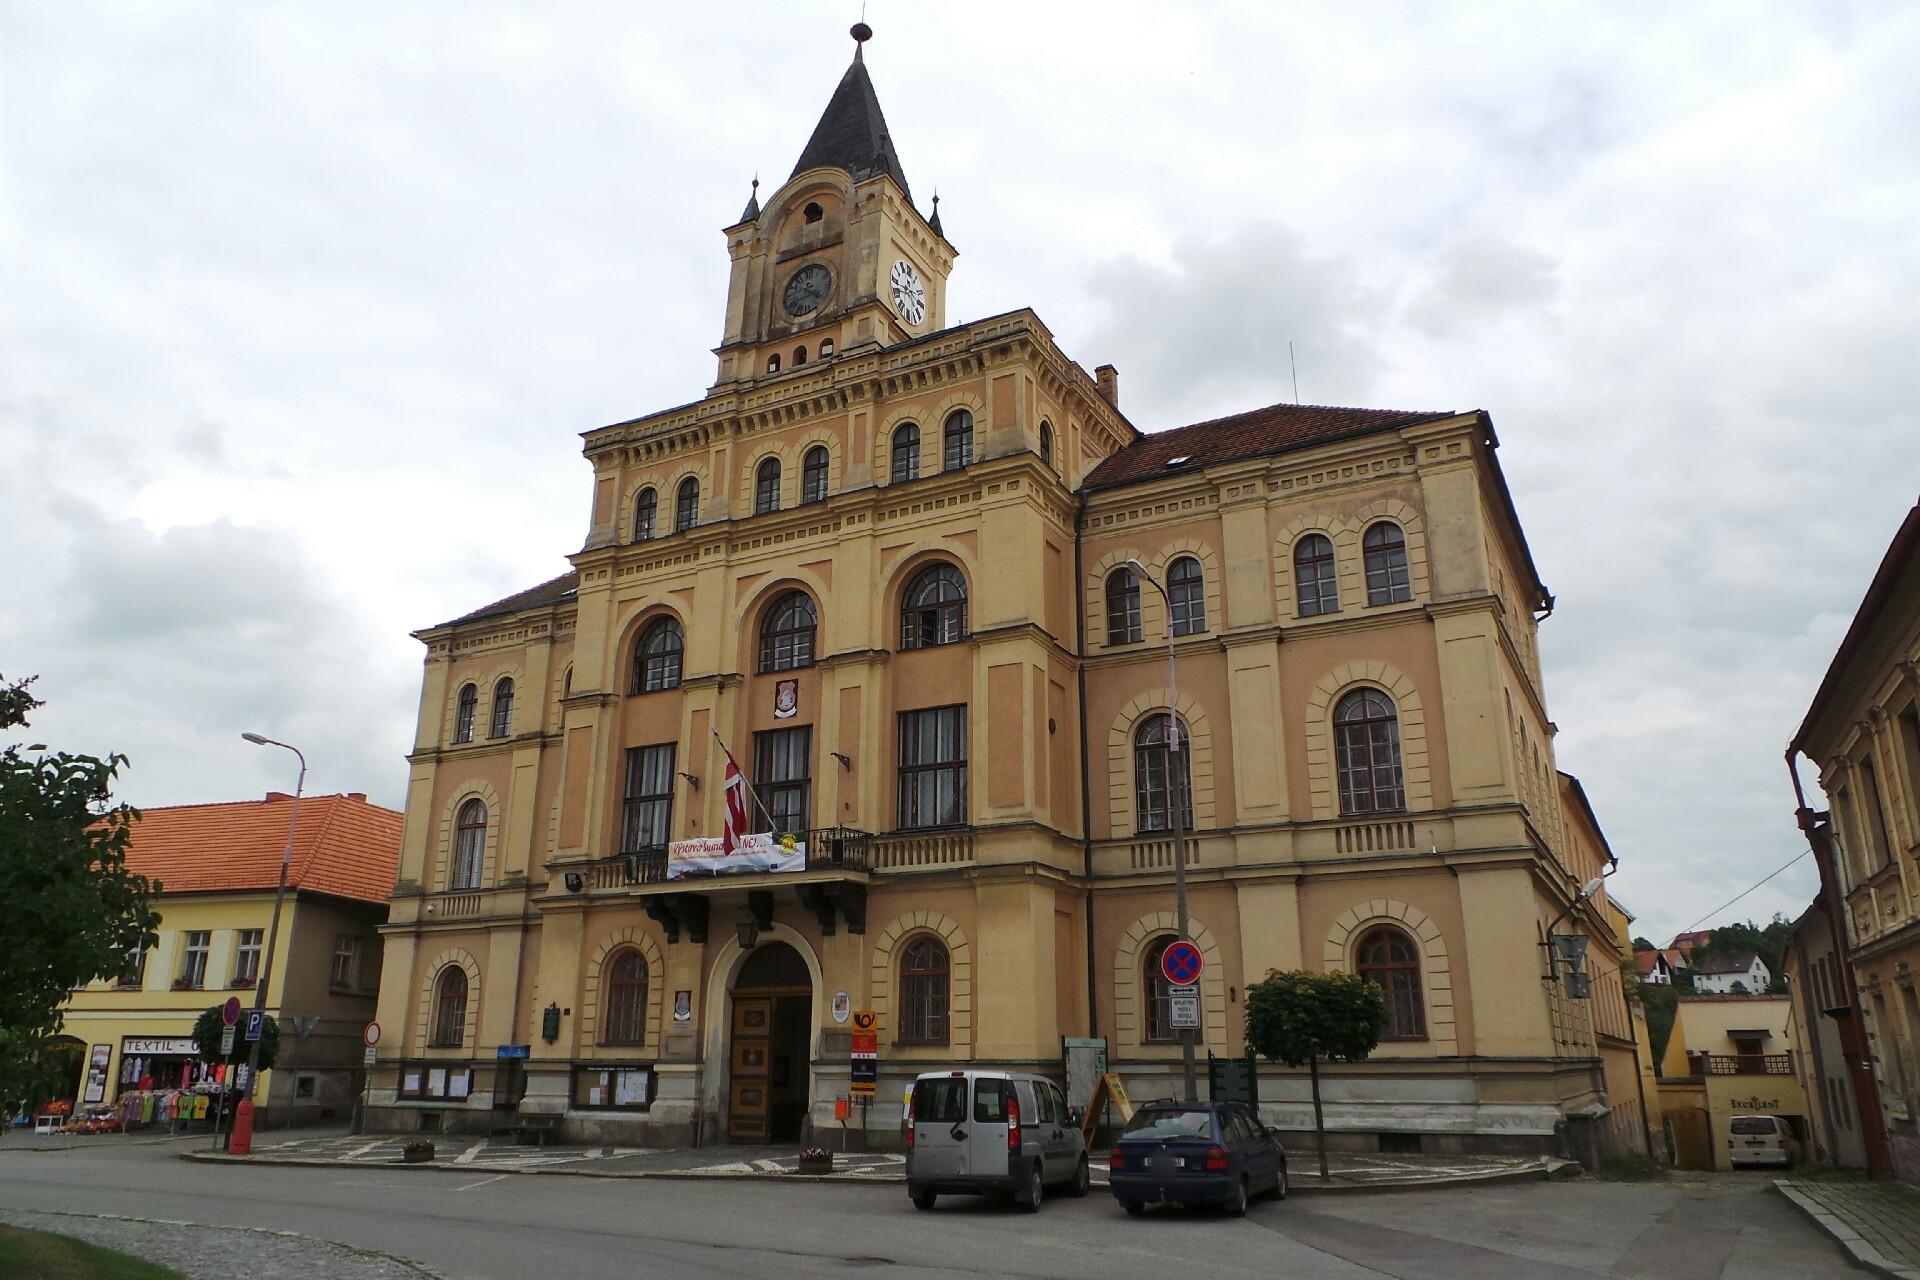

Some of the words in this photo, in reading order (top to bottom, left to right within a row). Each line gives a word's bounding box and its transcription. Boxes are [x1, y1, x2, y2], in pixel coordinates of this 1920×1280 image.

[703, 840, 725, 853] Šuma
[249, 1013, 260, 1031] P
[127, 1040, 173, 1051] TEXTIL
[191, 1040, 200, 1051] O
